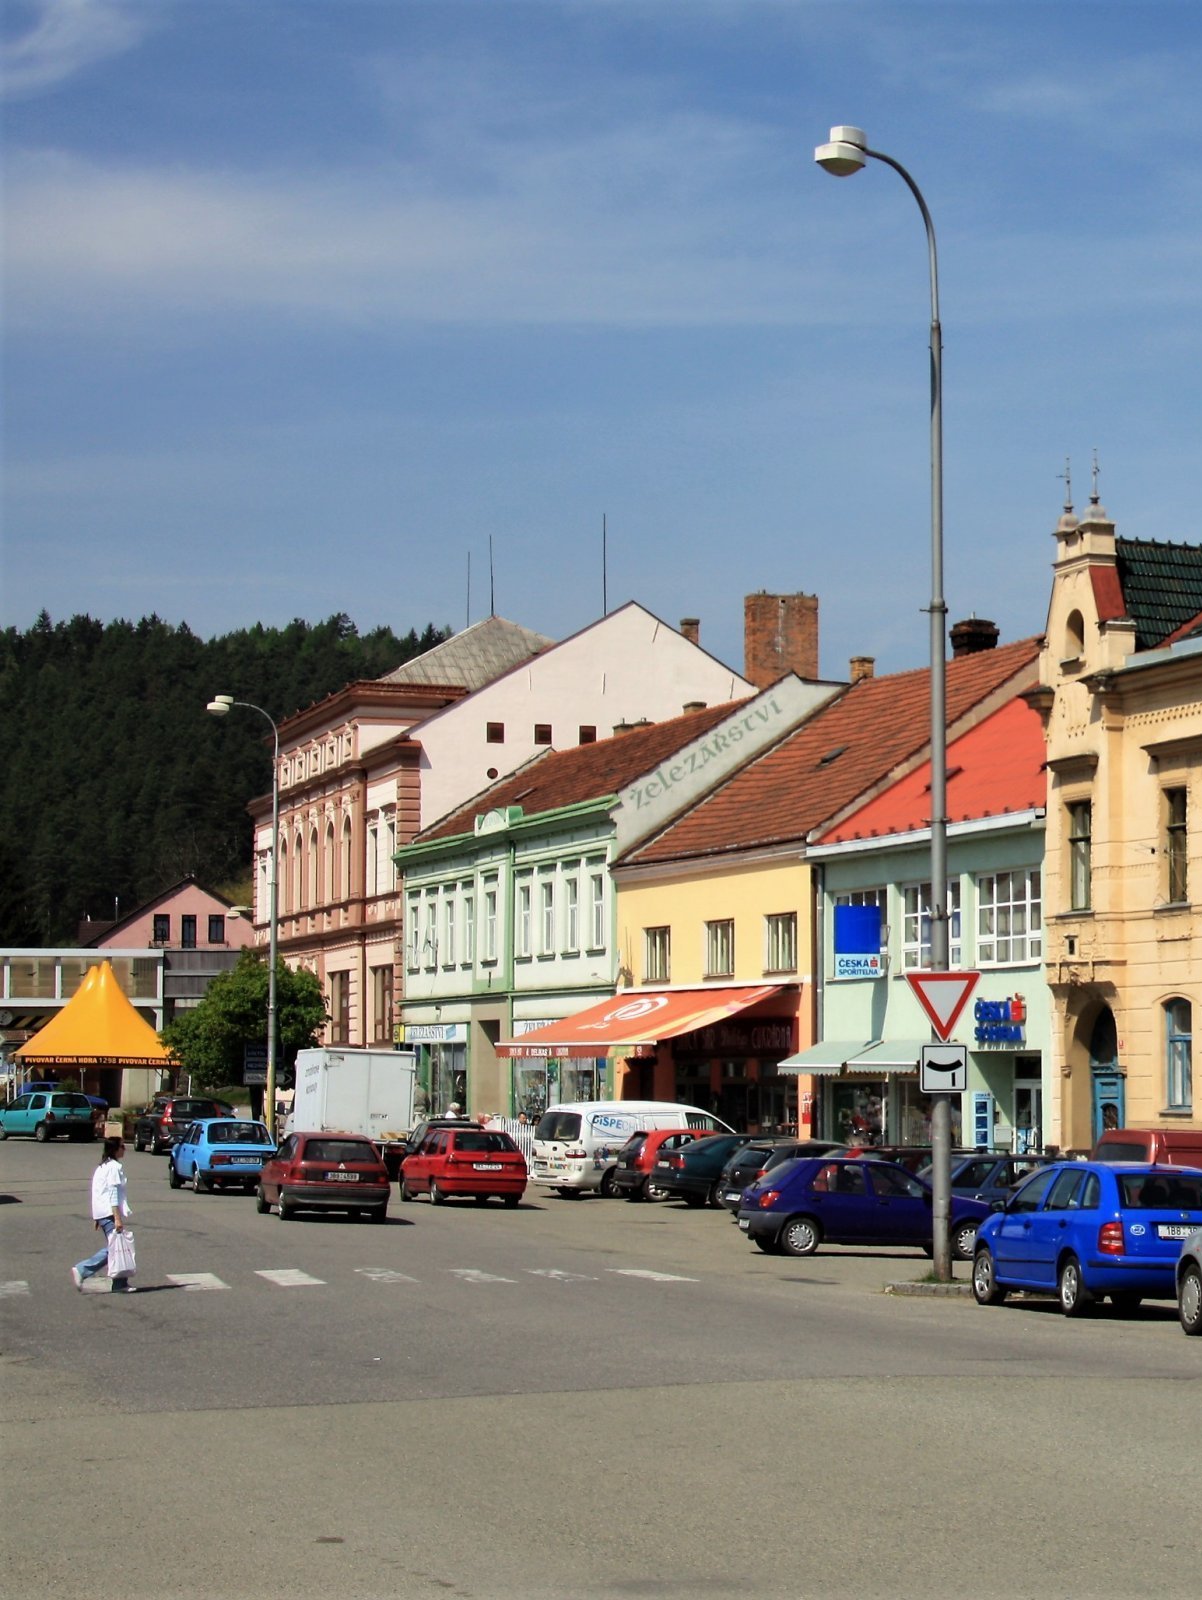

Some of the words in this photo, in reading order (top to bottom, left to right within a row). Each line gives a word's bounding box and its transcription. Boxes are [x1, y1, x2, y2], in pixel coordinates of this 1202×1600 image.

[838, 958, 870, 968] ČESKÁ
[838, 968, 879, 976] SPOŘITELNA
[55, 1056, 78, 1064] ČERNÁ
[148, 1058, 170, 1066] ČERNÁ
